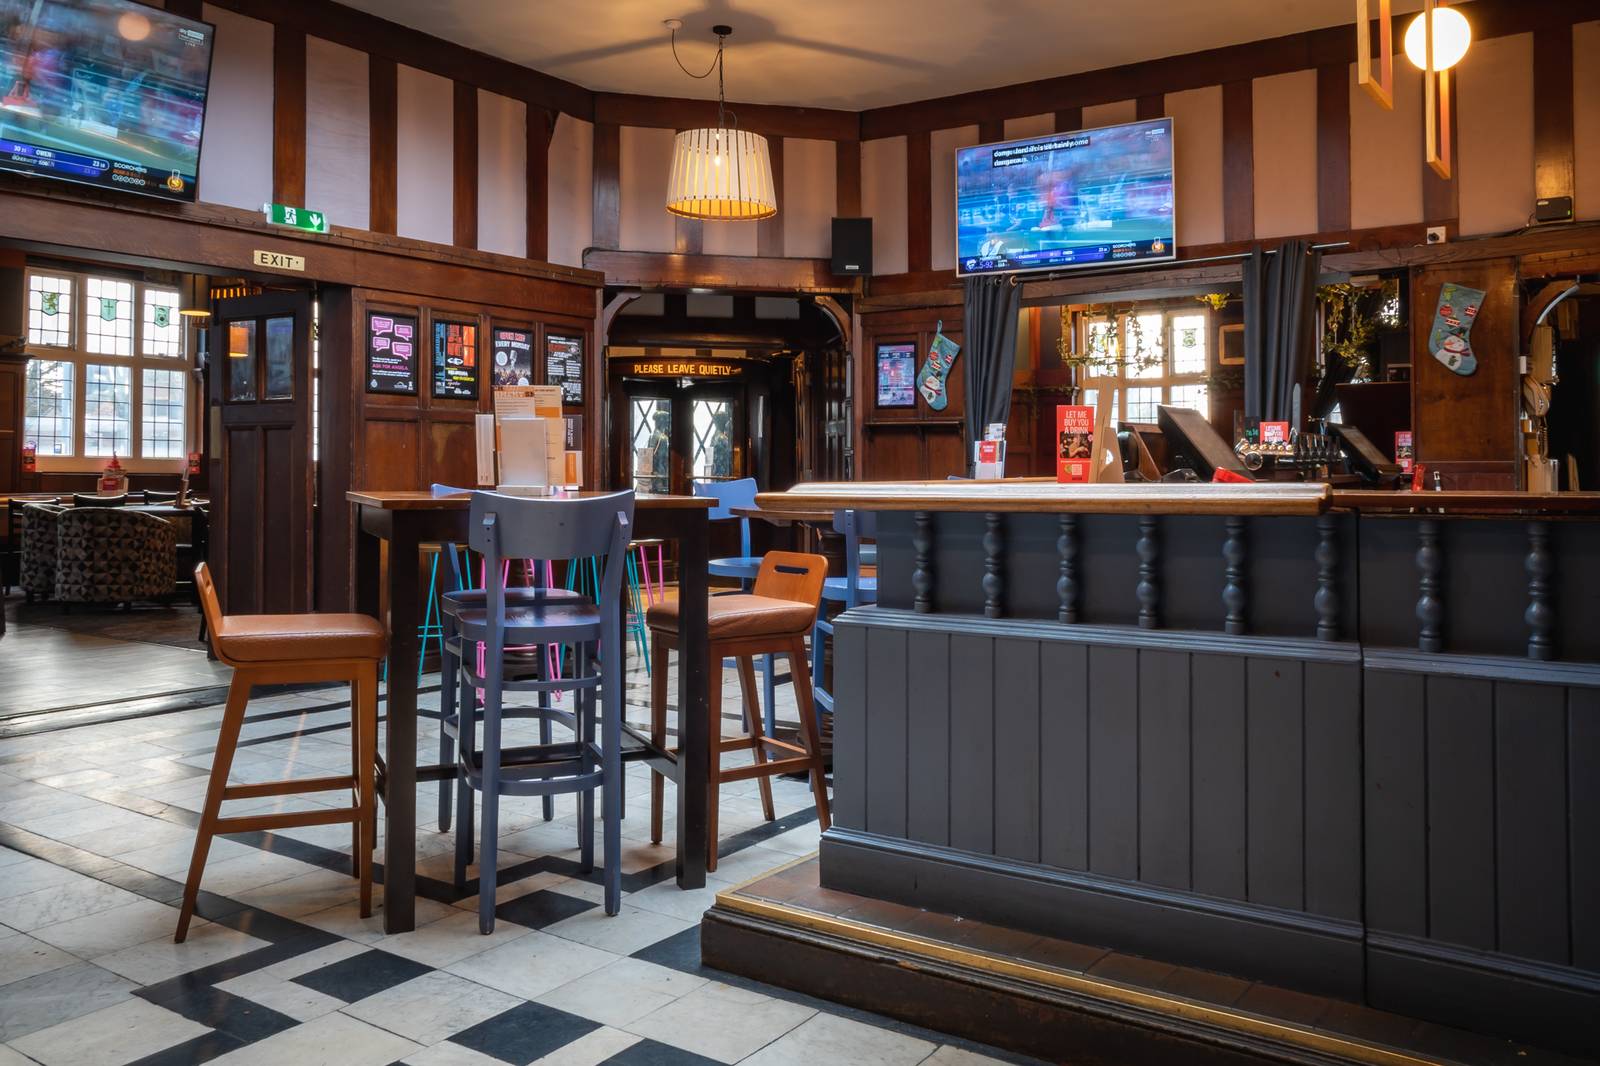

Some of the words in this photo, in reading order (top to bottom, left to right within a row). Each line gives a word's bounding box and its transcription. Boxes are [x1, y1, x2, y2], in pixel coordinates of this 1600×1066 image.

[261, 253, 294, 268] EXIT
[495, 340, 511, 348] EVERY
[511, 341, 531, 351] MONDAY
[633, 364, 664, 374] PLEASE
[667, 364, 696, 374] LEAVE
[699, 364, 732, 376] QUIETLY
[1065, 410, 1076, 418] LET
